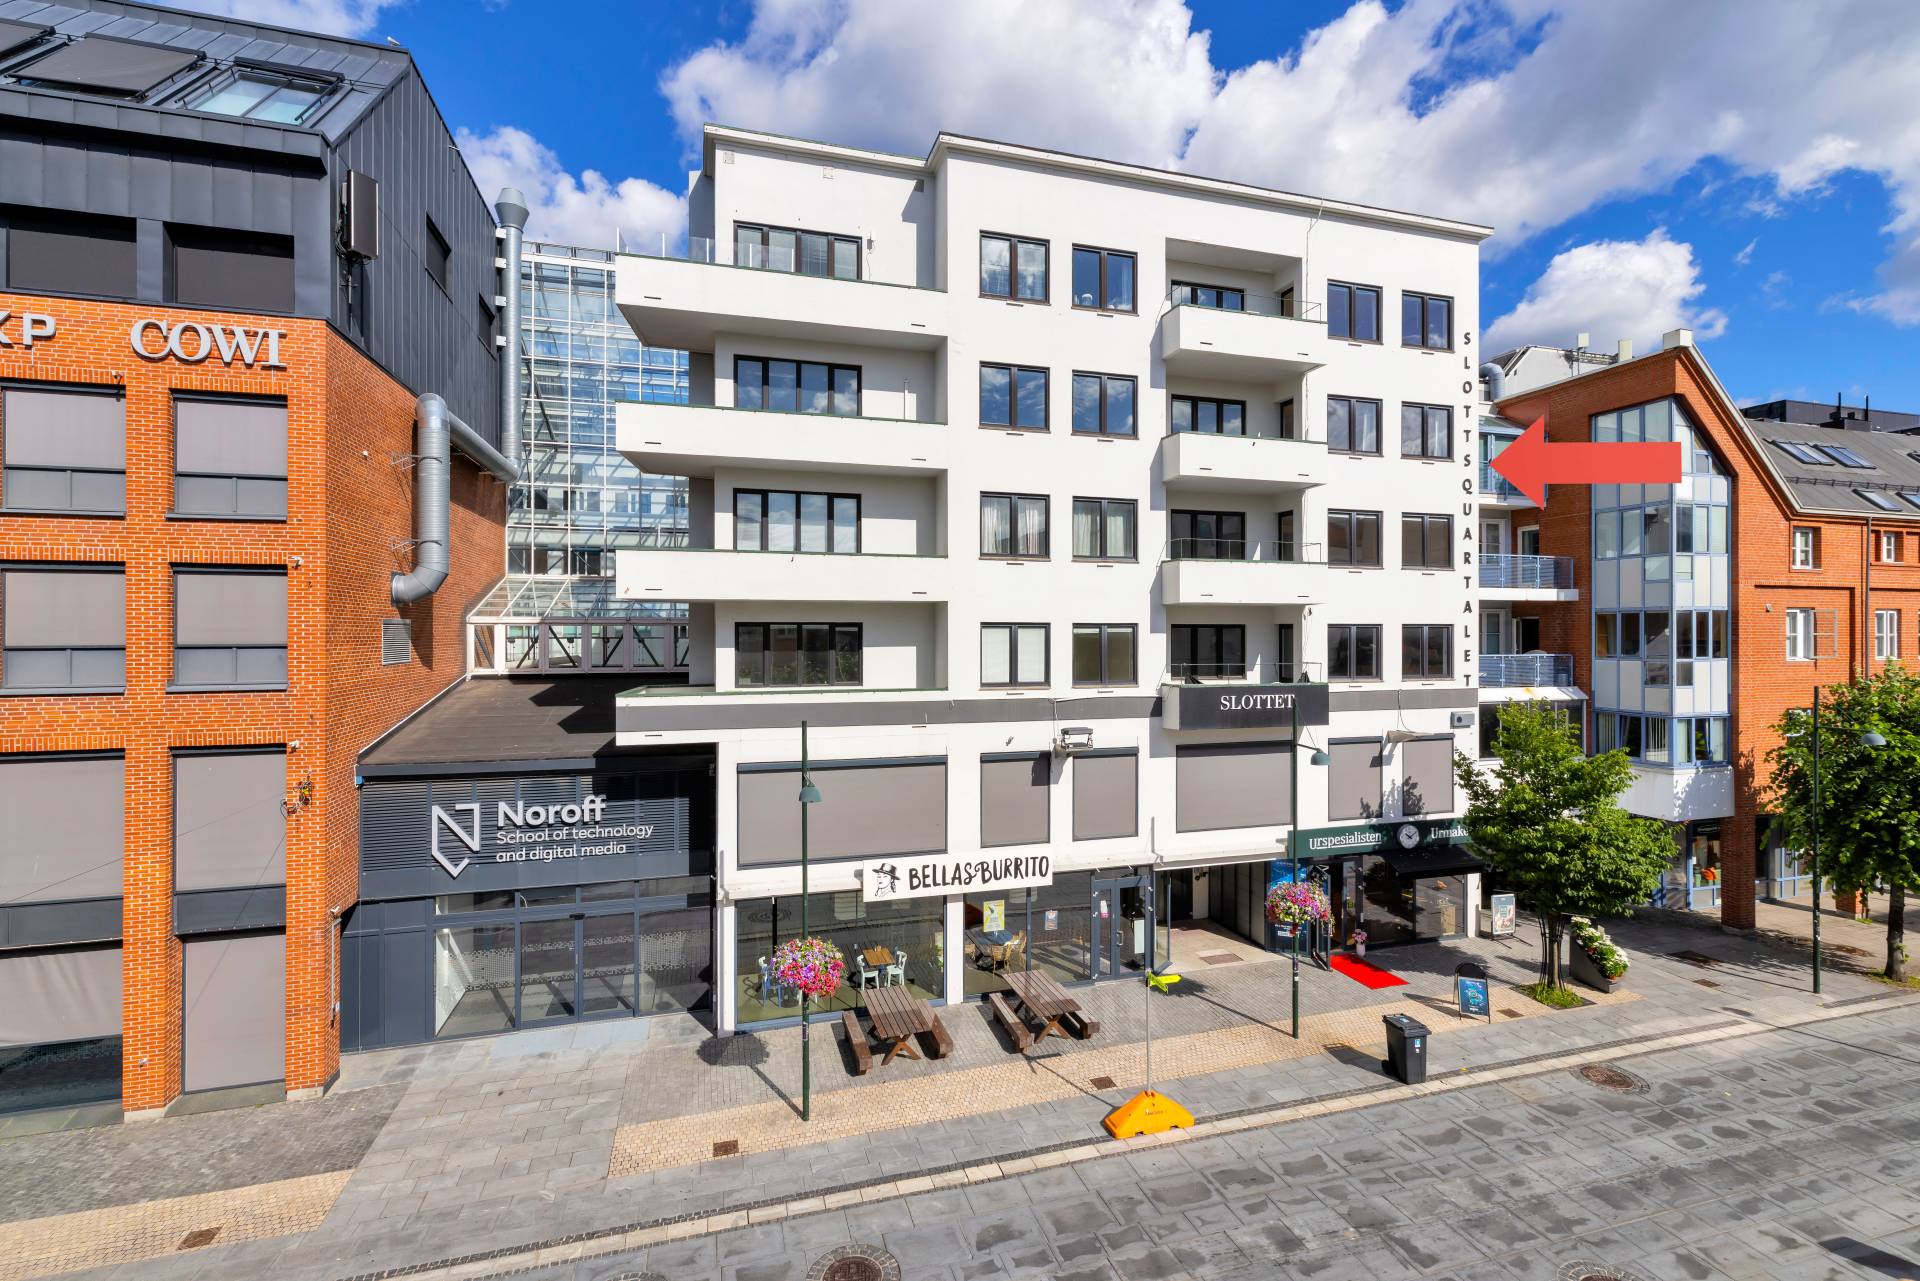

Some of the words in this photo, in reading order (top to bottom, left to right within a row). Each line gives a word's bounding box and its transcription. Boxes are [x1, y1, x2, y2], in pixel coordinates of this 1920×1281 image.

[131, 318, 288, 367] COWI
[1462, 332, 1473, 687] SLOTTSQUARTALET
[1220, 694, 1295, 711] SLOTTET
[497, 794, 606, 827] Noroff
[496, 828, 549, 845] School
[552, 826, 570, 841] of
[572, 823, 654, 840] technology
[1308, 832, 1382, 849] Urspesialisten
[496, 847, 526, 863] and
[529, 844, 577, 863] digital
[581, 841, 627, 856] media
